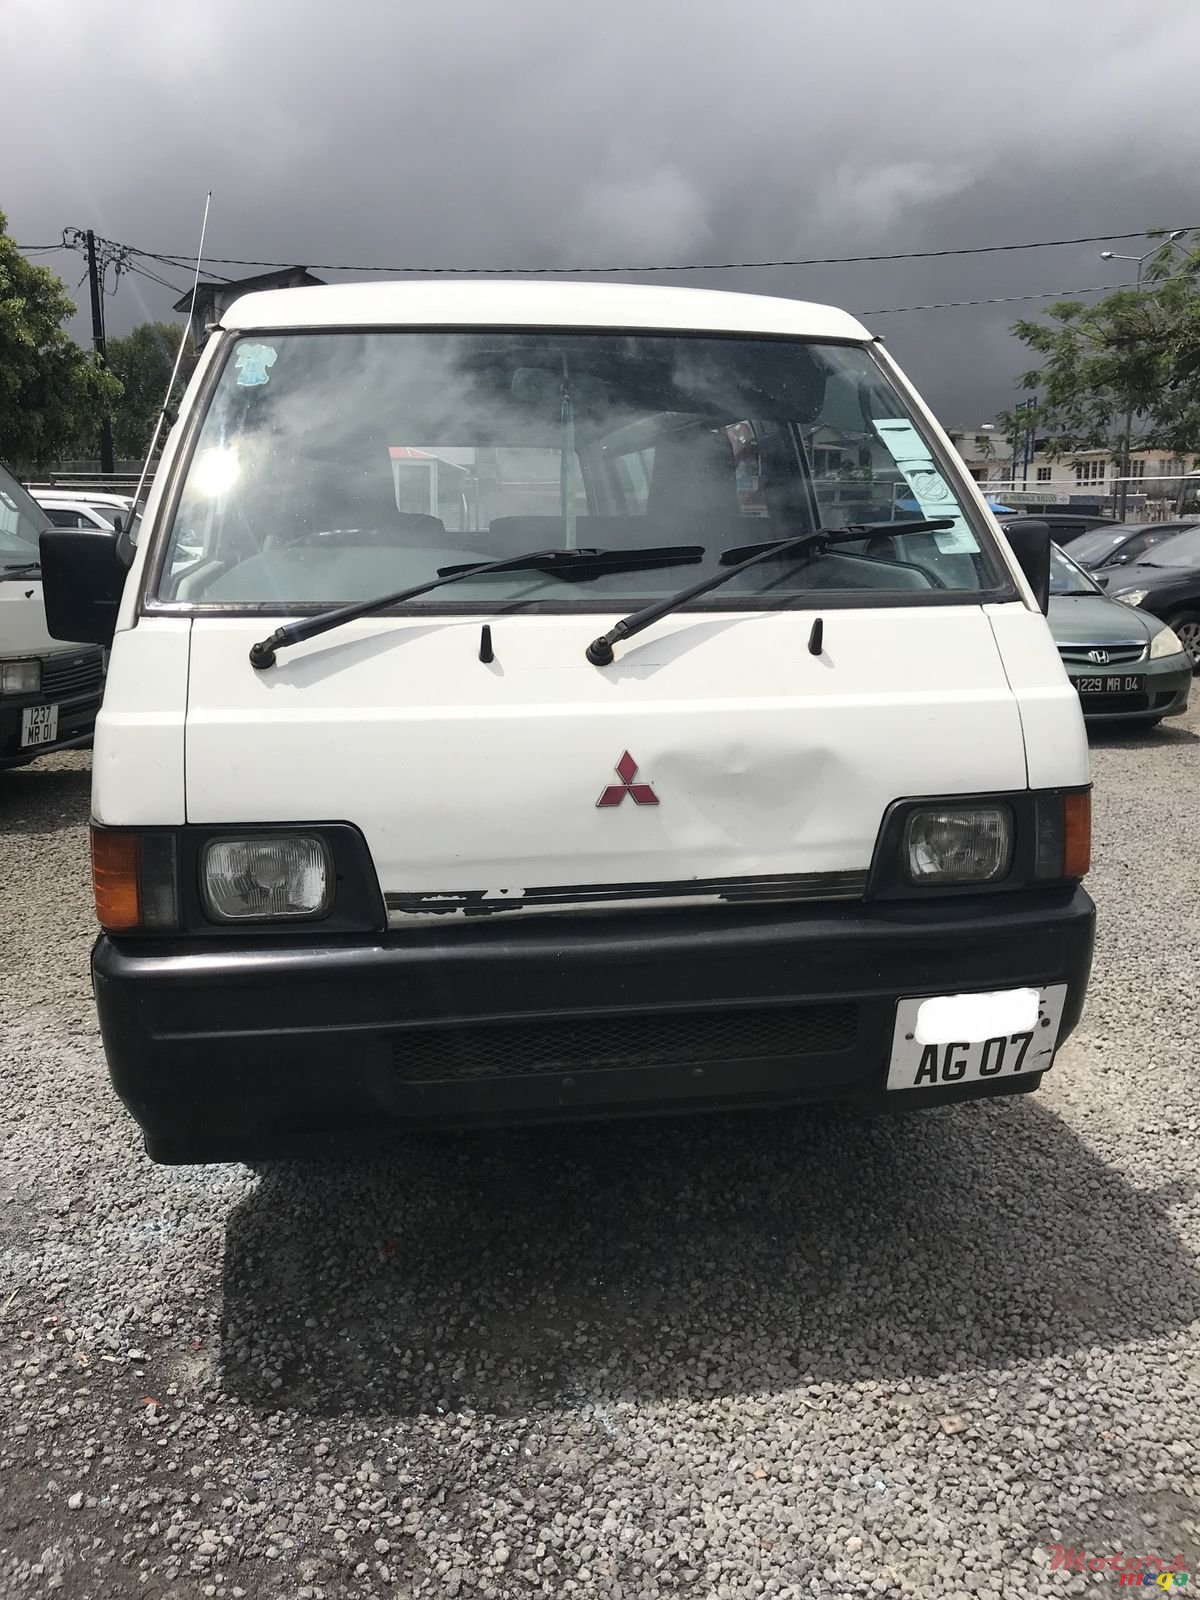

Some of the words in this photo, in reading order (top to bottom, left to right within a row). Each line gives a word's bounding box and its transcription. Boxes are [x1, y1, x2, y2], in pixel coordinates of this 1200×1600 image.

[1075, 678, 1102, 692] 1229
[1106, 677, 1121, 691] MR
[1124, 676, 1138, 691] 04
[30, 705, 52, 726] 1237
[27, 725, 41, 744] MR
[43, 723, 52, 741] 01
[913, 1042, 970, 1084] AG
[979, 1031, 1034, 1076] 07
